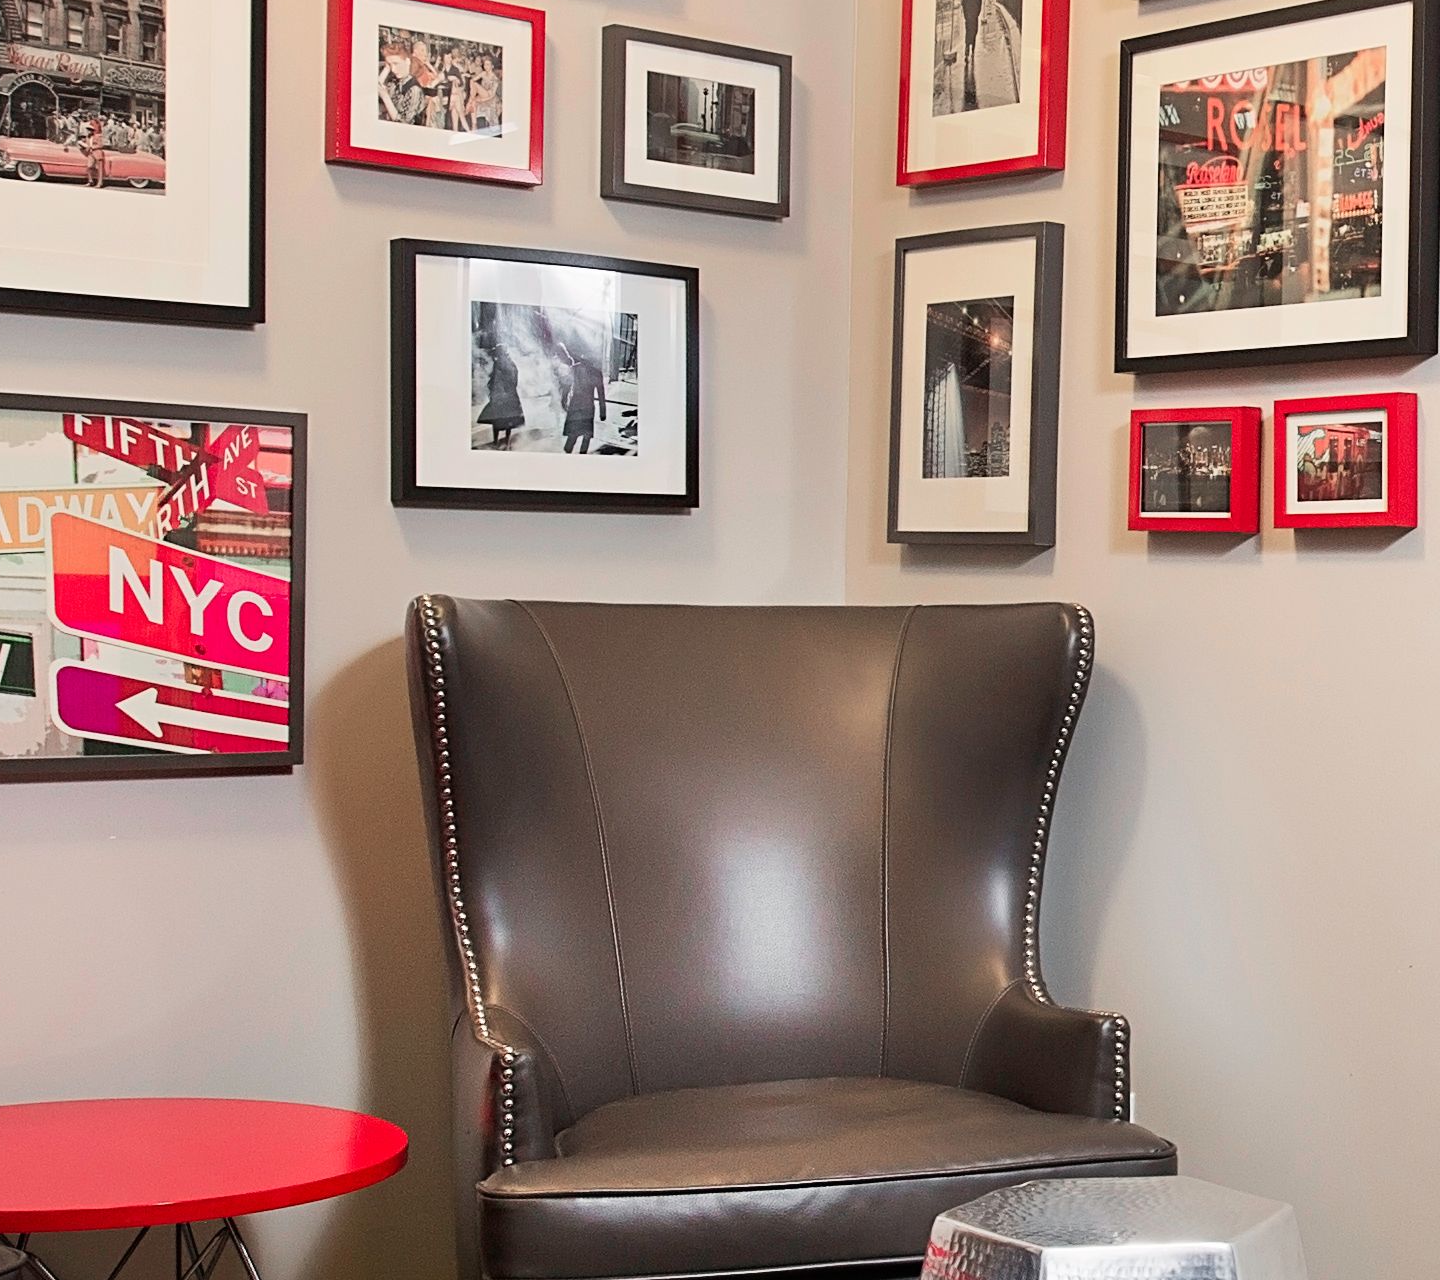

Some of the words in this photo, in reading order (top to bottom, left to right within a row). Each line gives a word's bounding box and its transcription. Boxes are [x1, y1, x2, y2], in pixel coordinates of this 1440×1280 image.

[223, 425, 253, 470] AVE
[235, 477, 258, 499] ST
[109, 545, 273, 652] NYC
